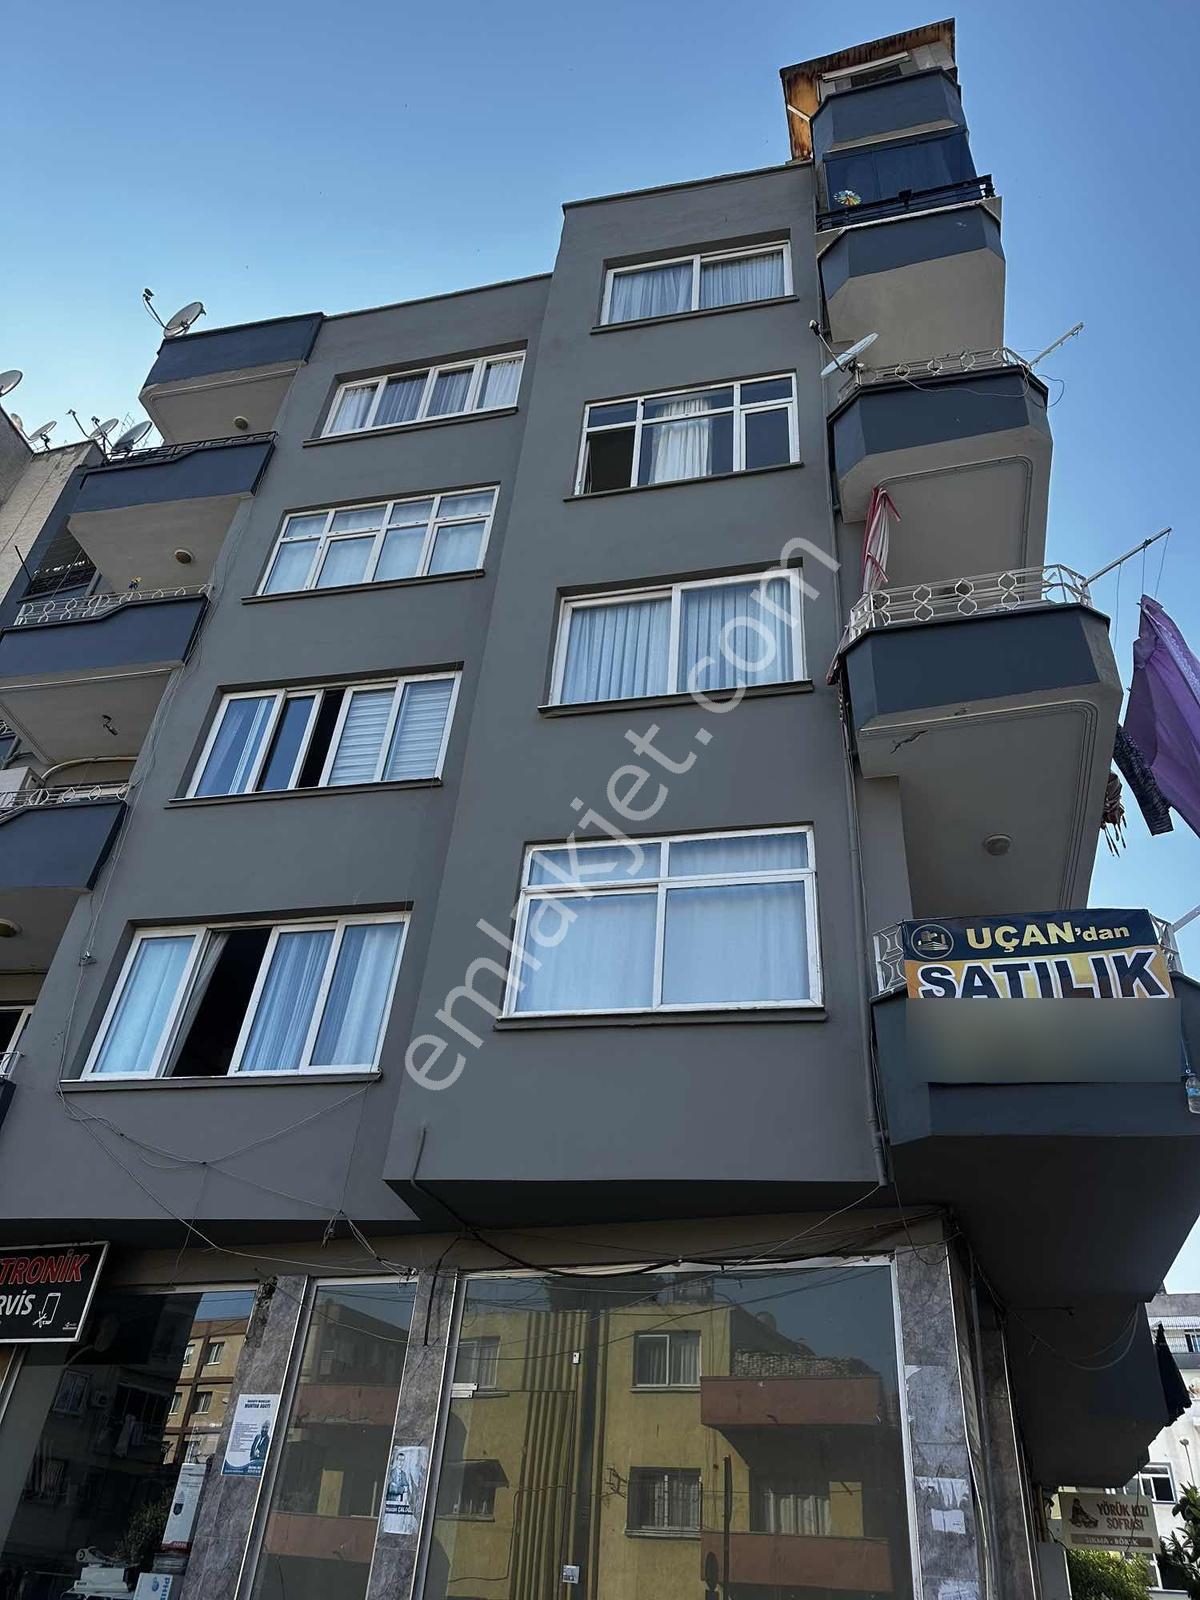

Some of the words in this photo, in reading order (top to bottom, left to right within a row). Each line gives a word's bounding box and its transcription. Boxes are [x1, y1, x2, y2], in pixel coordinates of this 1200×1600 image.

[965, 921, 1130, 952] UÇAN'dan
[917, 949, 1169, 998] SATILIK
[1097, 1500, 1130, 1517] YÖRÜK
[1106, 1517, 1144, 1531] SOFRASI
